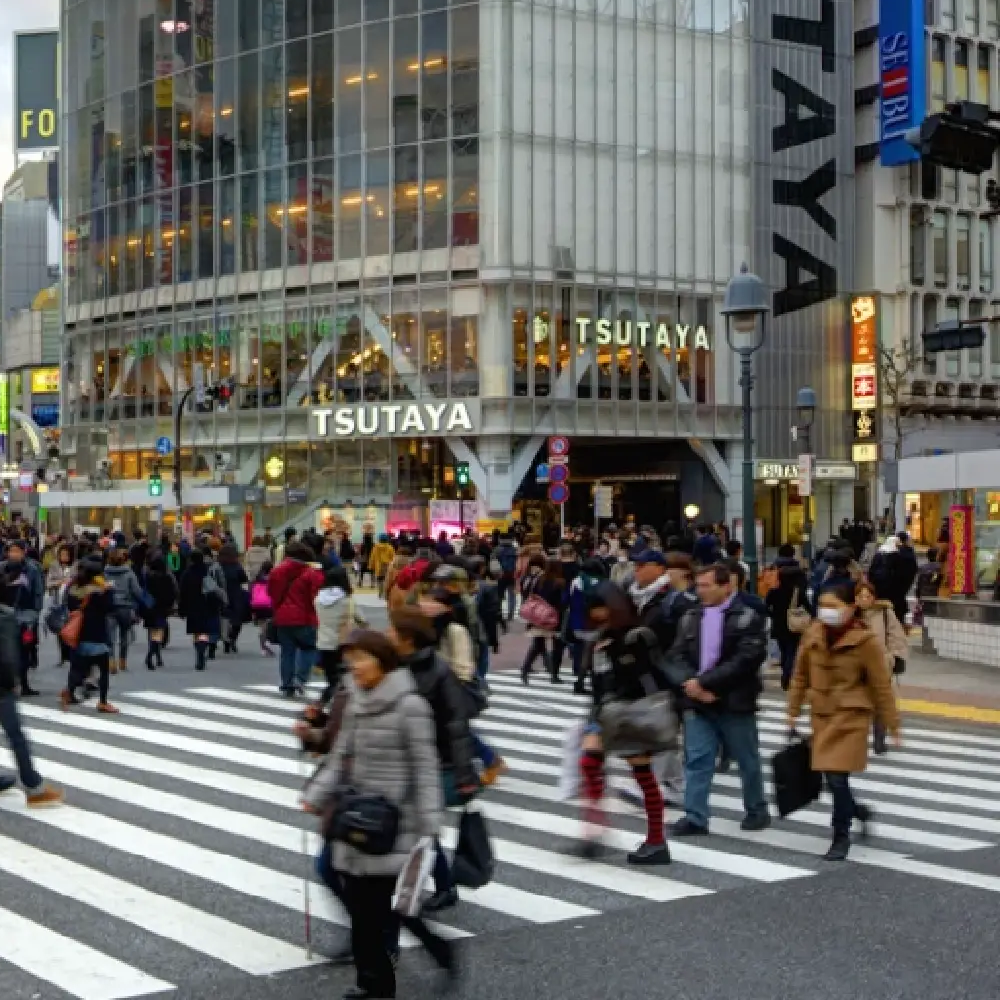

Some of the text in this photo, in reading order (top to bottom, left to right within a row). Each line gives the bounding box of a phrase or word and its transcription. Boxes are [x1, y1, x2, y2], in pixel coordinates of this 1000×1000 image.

[881, 31, 909, 140] SEIBU
[21, 108, 56, 138] FO
[575, 316, 711, 350] TSUTAYA
[311, 401, 474, 437] TSUTAYA
